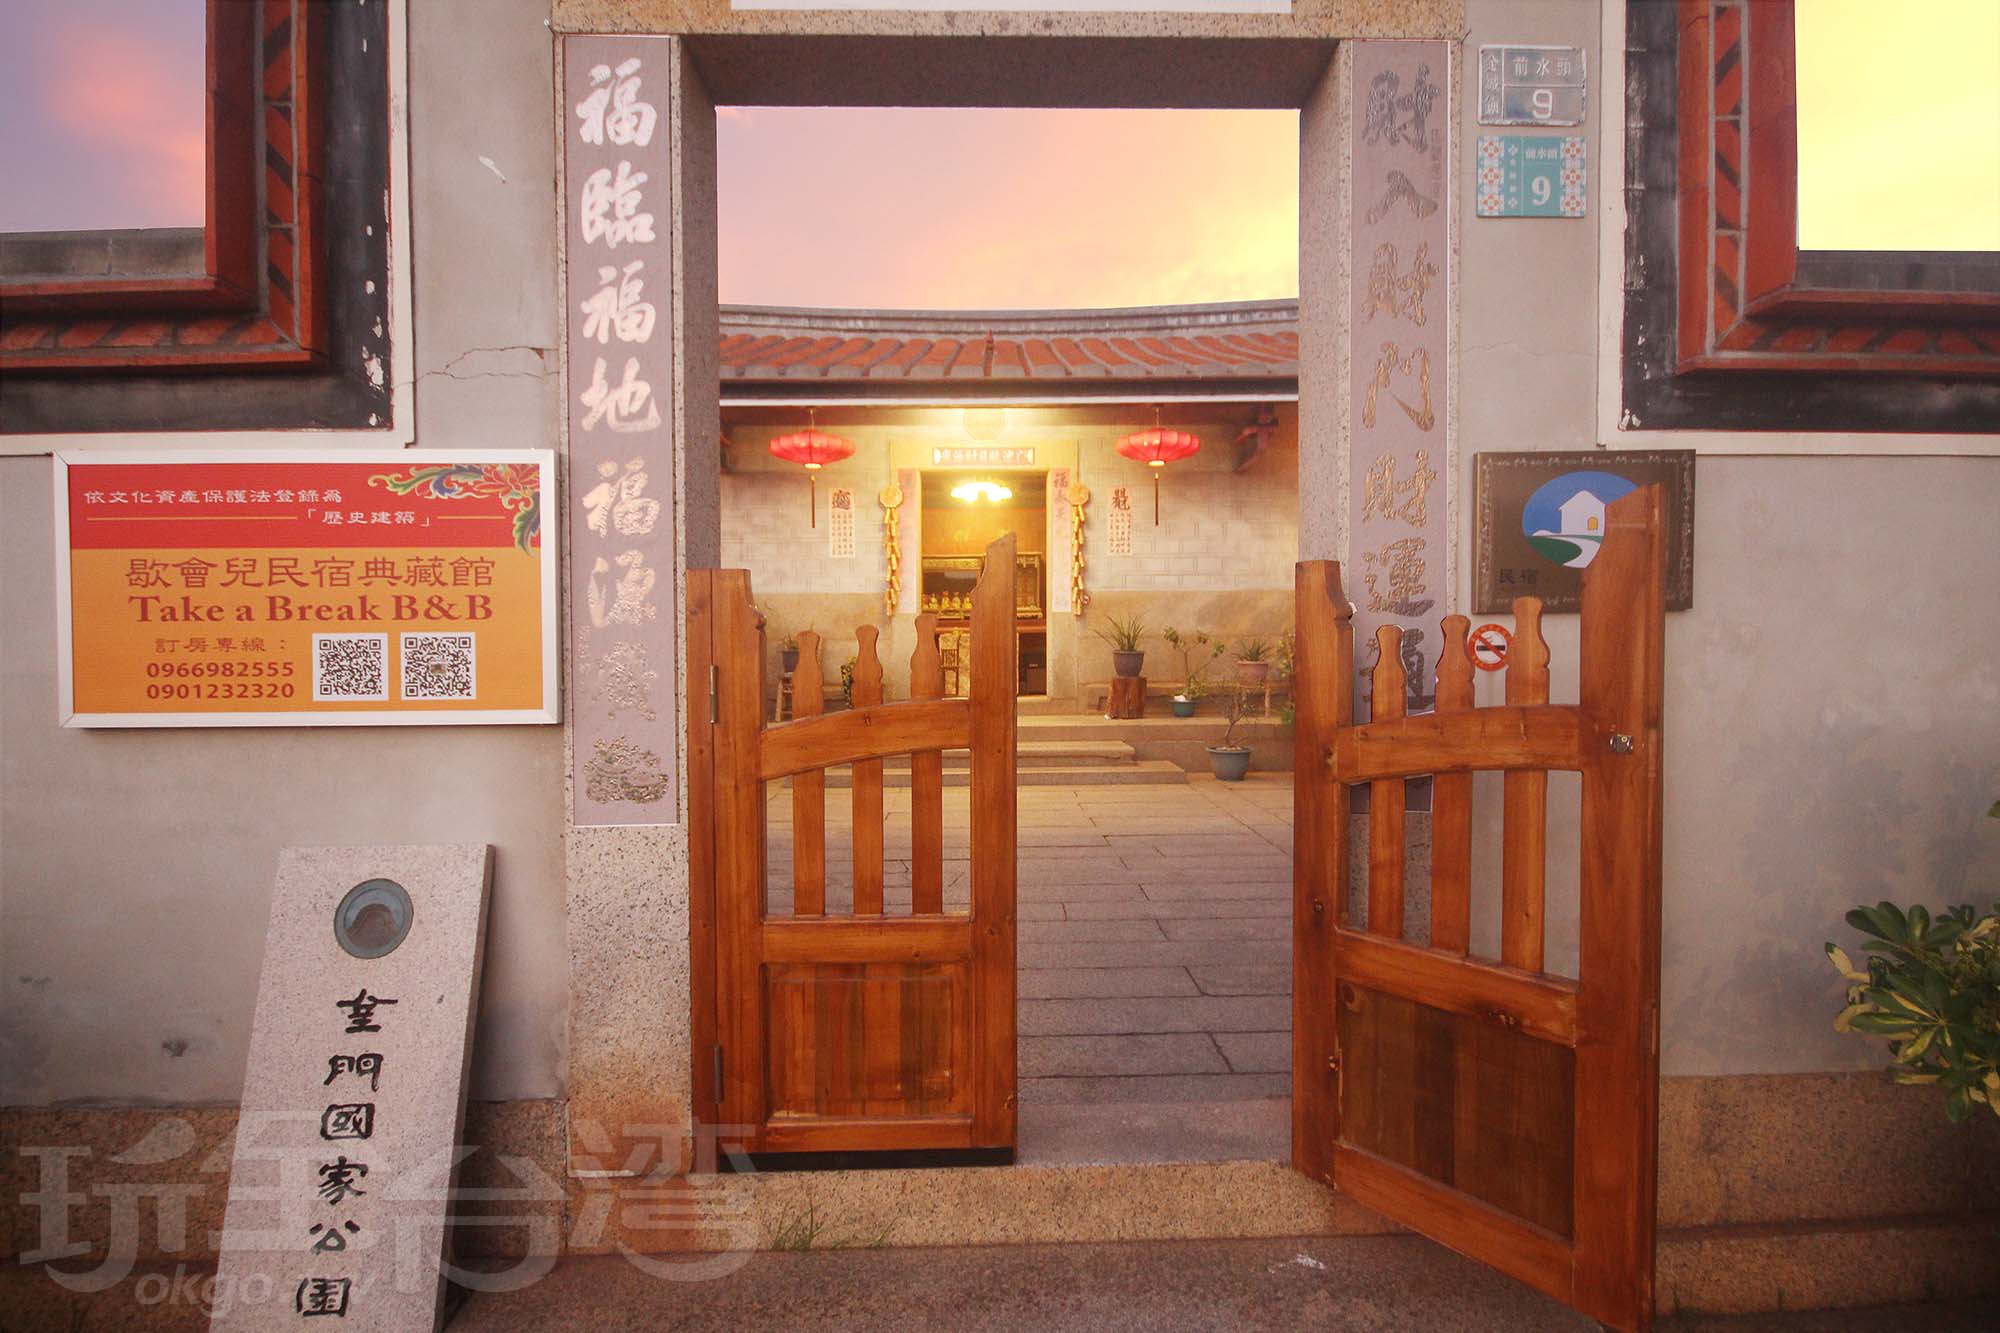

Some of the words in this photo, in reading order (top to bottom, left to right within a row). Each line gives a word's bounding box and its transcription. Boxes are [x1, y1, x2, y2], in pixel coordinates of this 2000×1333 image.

[1532, 88, 1553, 120] 9
[1531, 175, 1552, 206] 9
[125, 555, 495, 588] 歇會兒民宿典藏館
[1499, 568, 1538, 584] 民宿
[127, 595, 224, 622] Take
[235, 602, 255, 622] a
[265, 593, 381, 622] Break
[391, 594, 493, 622] B&B
[146, 661, 294, 678] 0966982555
[146, 683, 295, 699] 0901232320
[296, 988, 398, 1317] 金門國家公園
